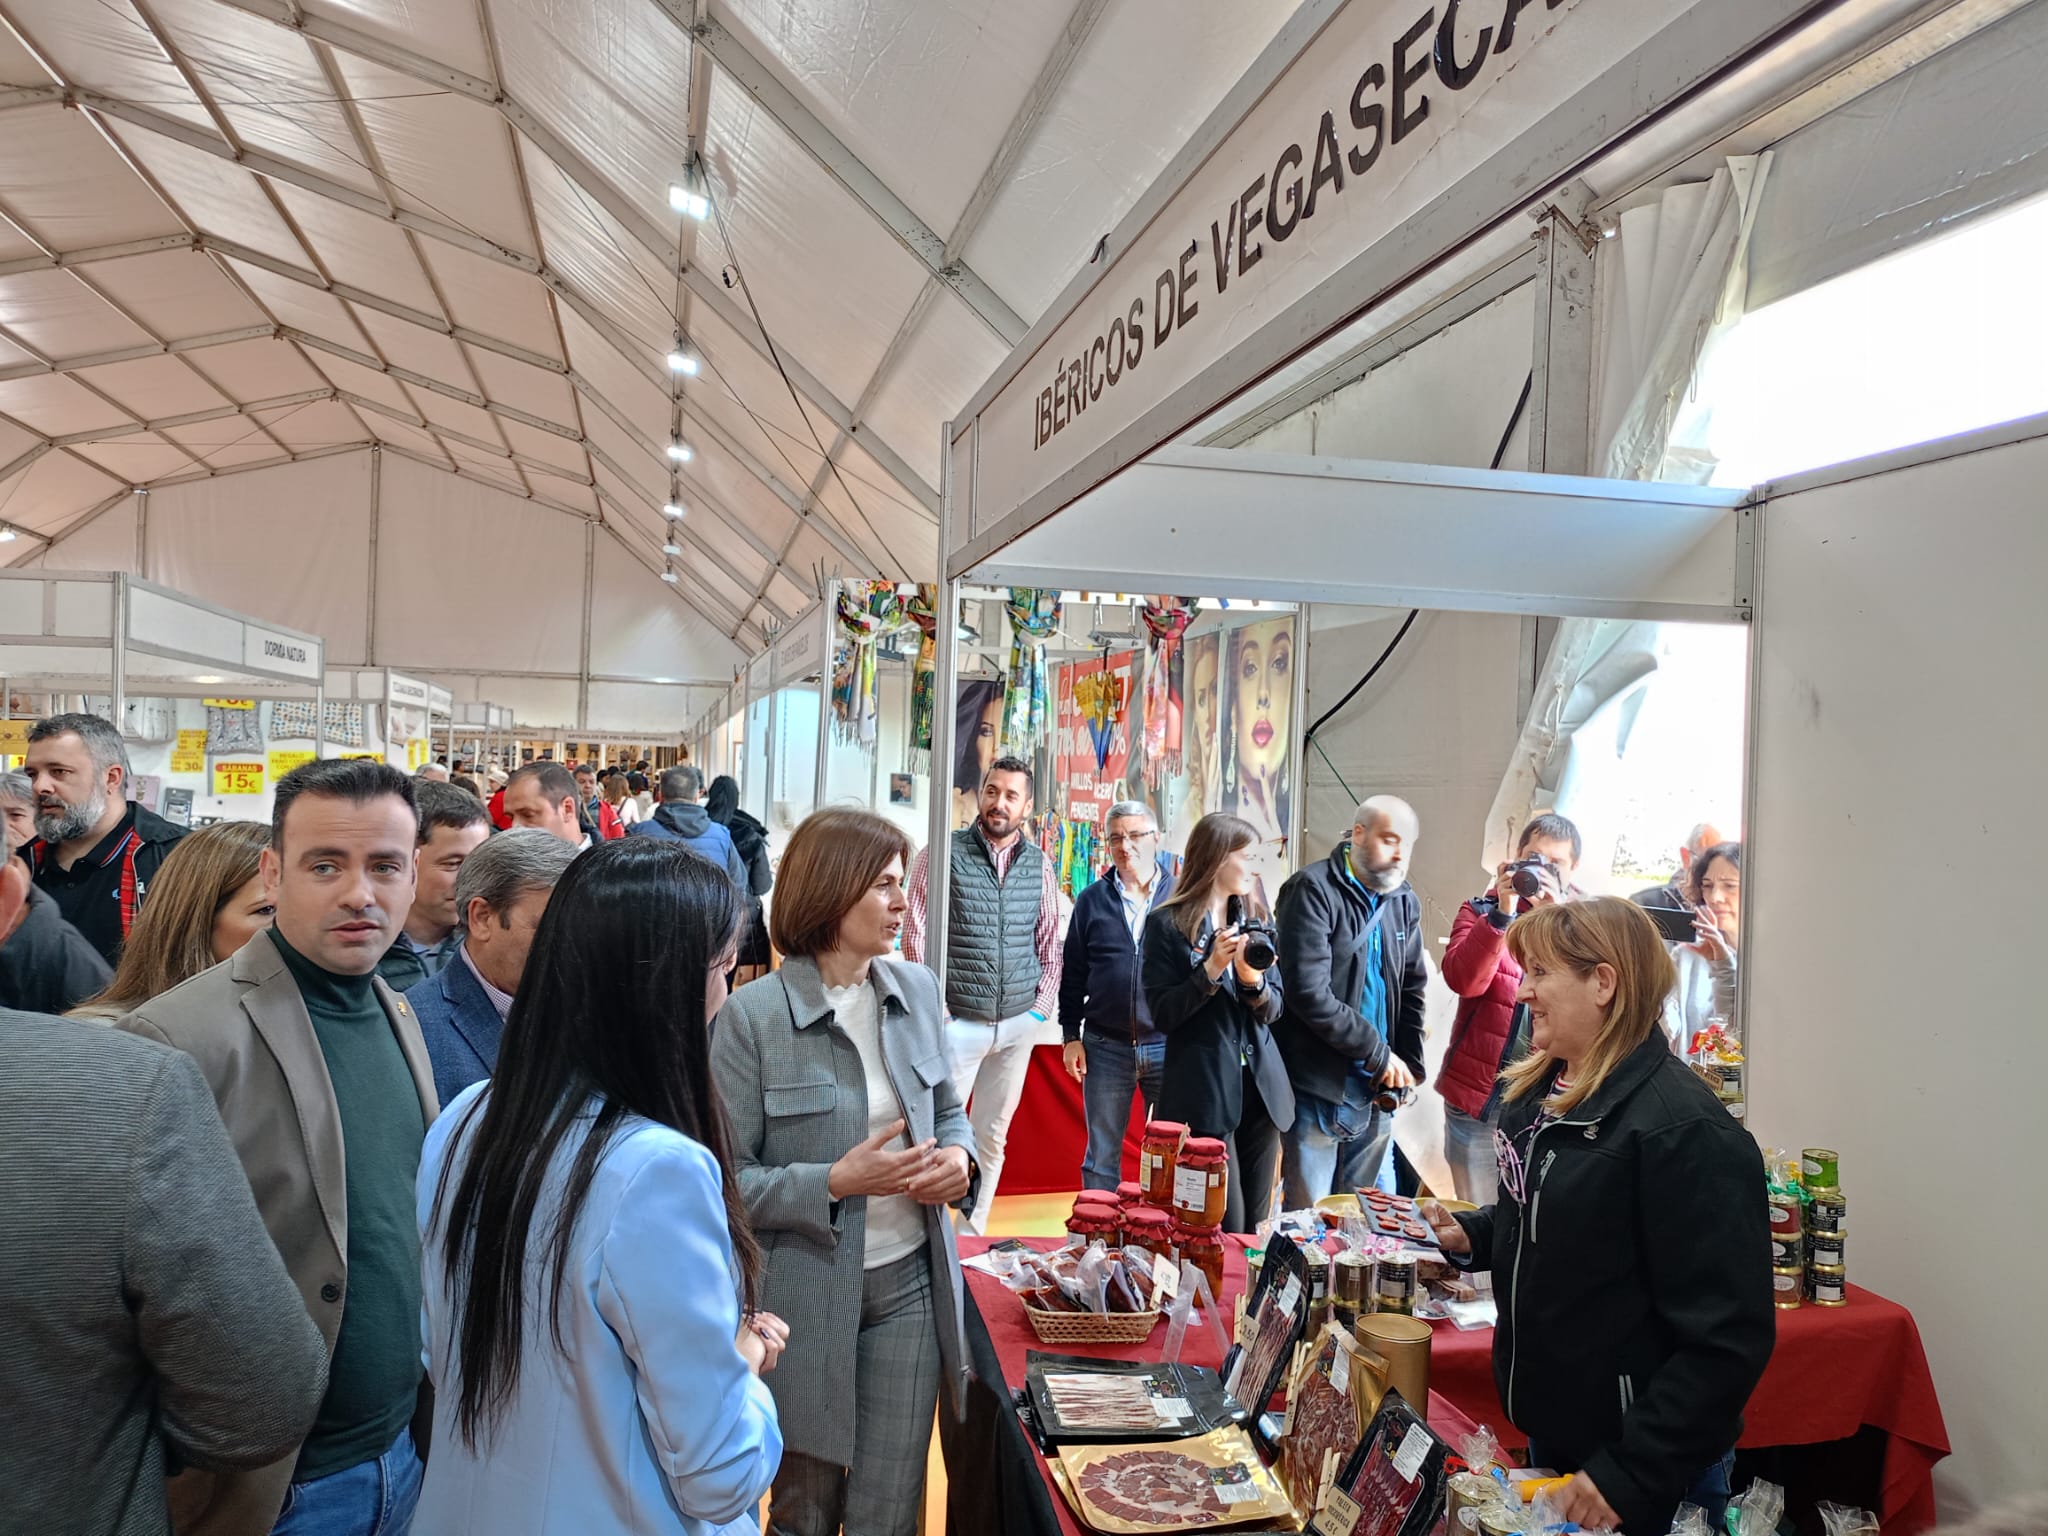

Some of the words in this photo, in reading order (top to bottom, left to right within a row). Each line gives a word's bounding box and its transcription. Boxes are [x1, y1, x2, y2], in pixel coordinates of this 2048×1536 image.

[1034, 297, 1144, 451] IBÉRICOS
[1154, 238, 1200, 350] DE
[223, 773, 256, 789] 15€
